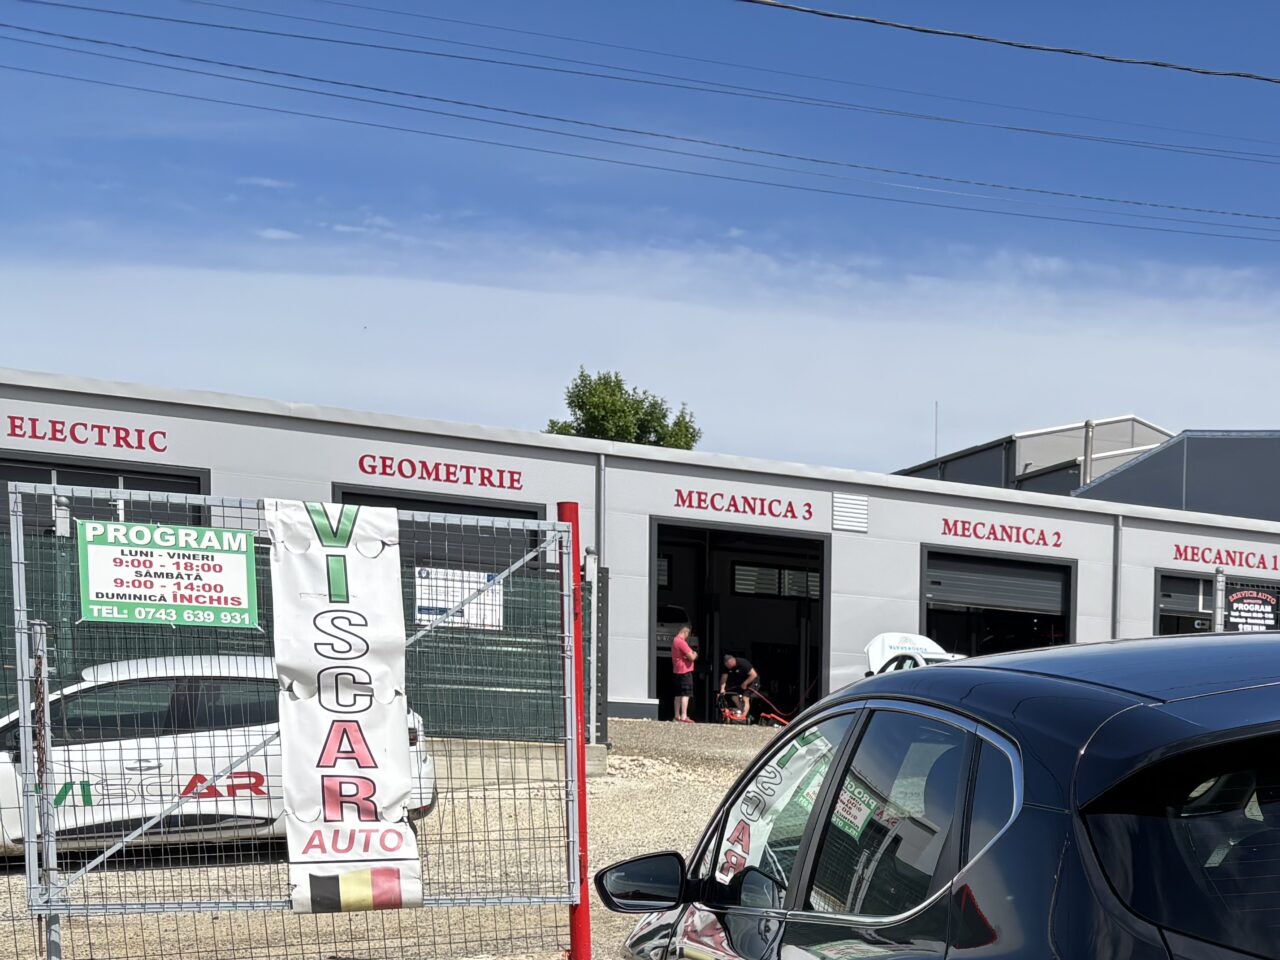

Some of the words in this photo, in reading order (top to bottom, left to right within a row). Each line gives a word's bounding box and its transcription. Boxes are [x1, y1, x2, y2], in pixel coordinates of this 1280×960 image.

[6, 415, 168, 453] ELECTRIC
[358, 454, 523, 491] GEOMETRIE
[674, 488, 798, 519] MECANICA
[802, 502, 813, 521] 3
[85, 522, 247, 552] PROGRAM
[941, 517, 1049, 547] MECANICA
[1052, 531, 1063, 548] 2
[112, 557, 153, 569] 9:00
[172, 561, 223, 573] 18:00
[120, 549, 154, 558] LUNI
[166, 552, 215, 562] VINERI
[1173, 544, 1268, 570] MECANICA
[1271, 555, 1279, 571] 1
[113, 578, 154, 589] 9:00
[173, 581, 224, 593] 14:00
[171, 590, 242, 606] ÎNCHIS
[89, 605, 128, 618] TEL:
[134, 607, 177, 620] 0743
[183, 610, 214, 623] 639
[220, 612, 250, 624] 931
[1233, 603, 1272, 612] PROGRAM
[303, 501, 381, 823] VISCAR
[302, 828, 404, 855] AUTO
